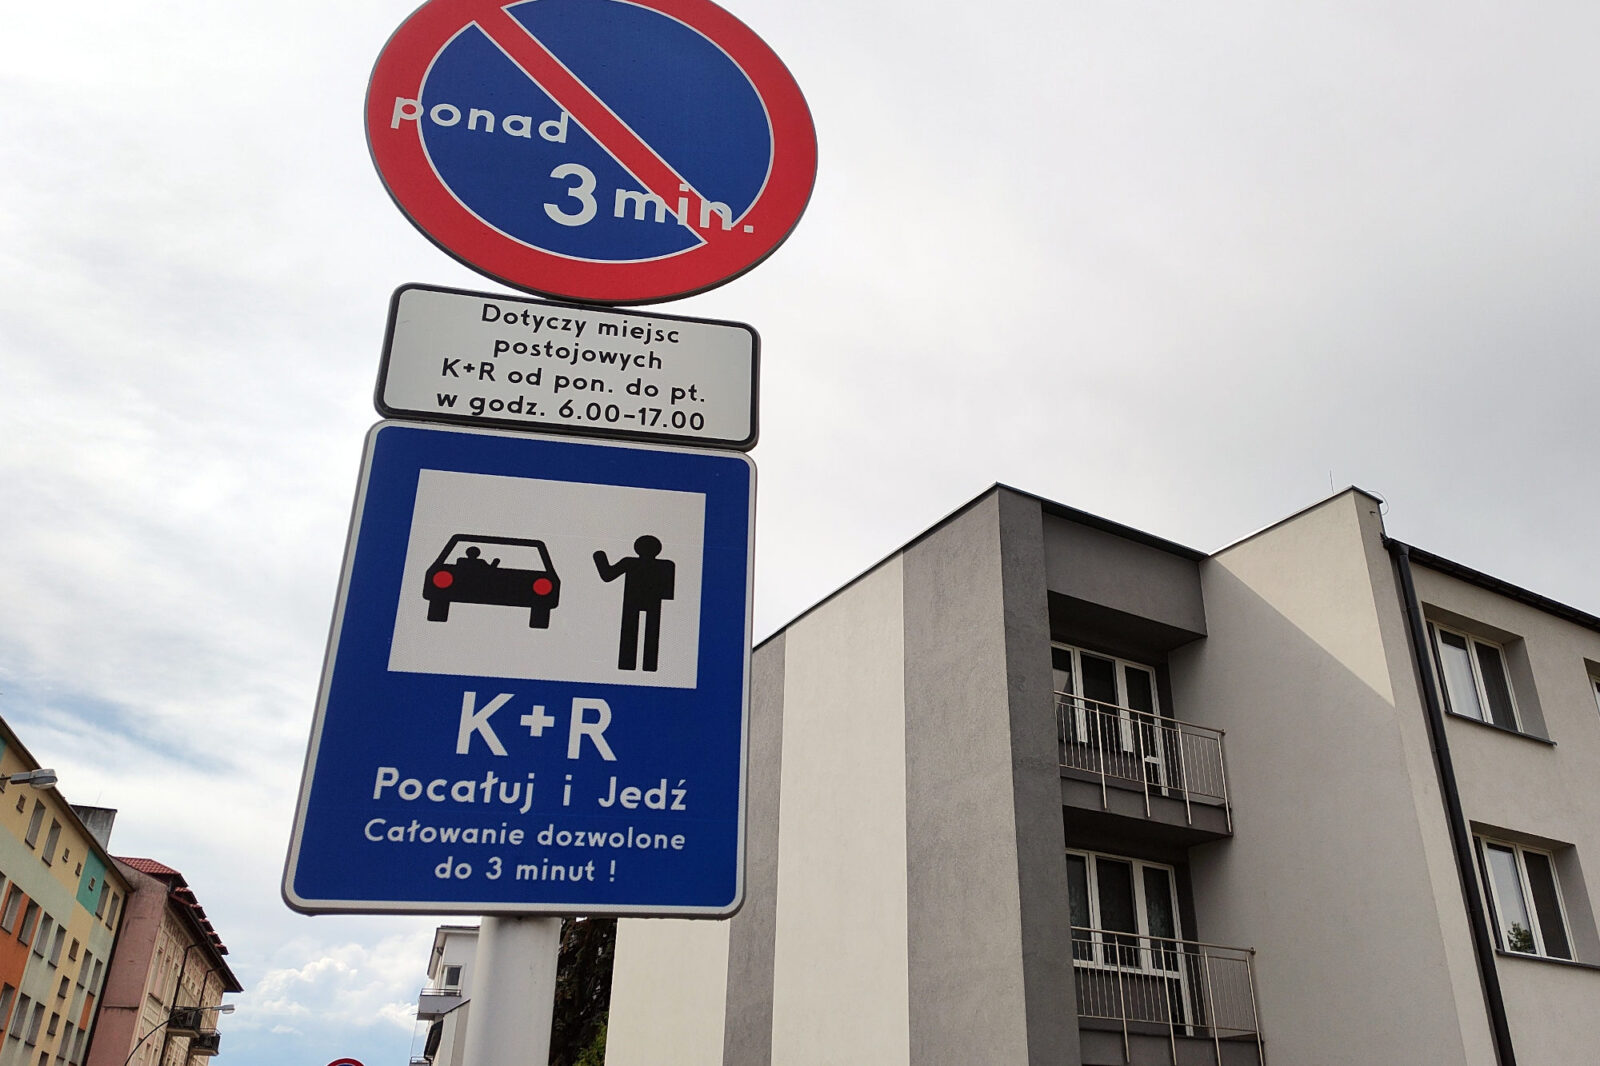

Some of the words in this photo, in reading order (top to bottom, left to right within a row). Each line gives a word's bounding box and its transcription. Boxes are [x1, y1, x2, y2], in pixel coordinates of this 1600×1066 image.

[390, 96, 569, 143] ponad
[543, 163, 598, 227] 3
[613, 183, 754, 233] min.
[481, 303, 587, 337] Dotyczy
[597, 320, 680, 345] miejsc
[493, 339, 662, 371] postojowych
[436, 393, 457, 407] w
[470, 396, 545, 416] godz.
[507, 367, 543, 386] od
[553, 374, 614, 393] pon.
[625, 378, 659, 398] do
[670, 384, 705, 405] pt.
[372, 766, 535, 815] Pocałuj
[562, 774, 573, 806] i
[598, 776, 687, 811] Jedź
[364, 818, 524, 845] Całowanie
[536, 824, 686, 850] dozwolone
[434, 856, 472, 880] do
[485, 856, 502, 880] 3
